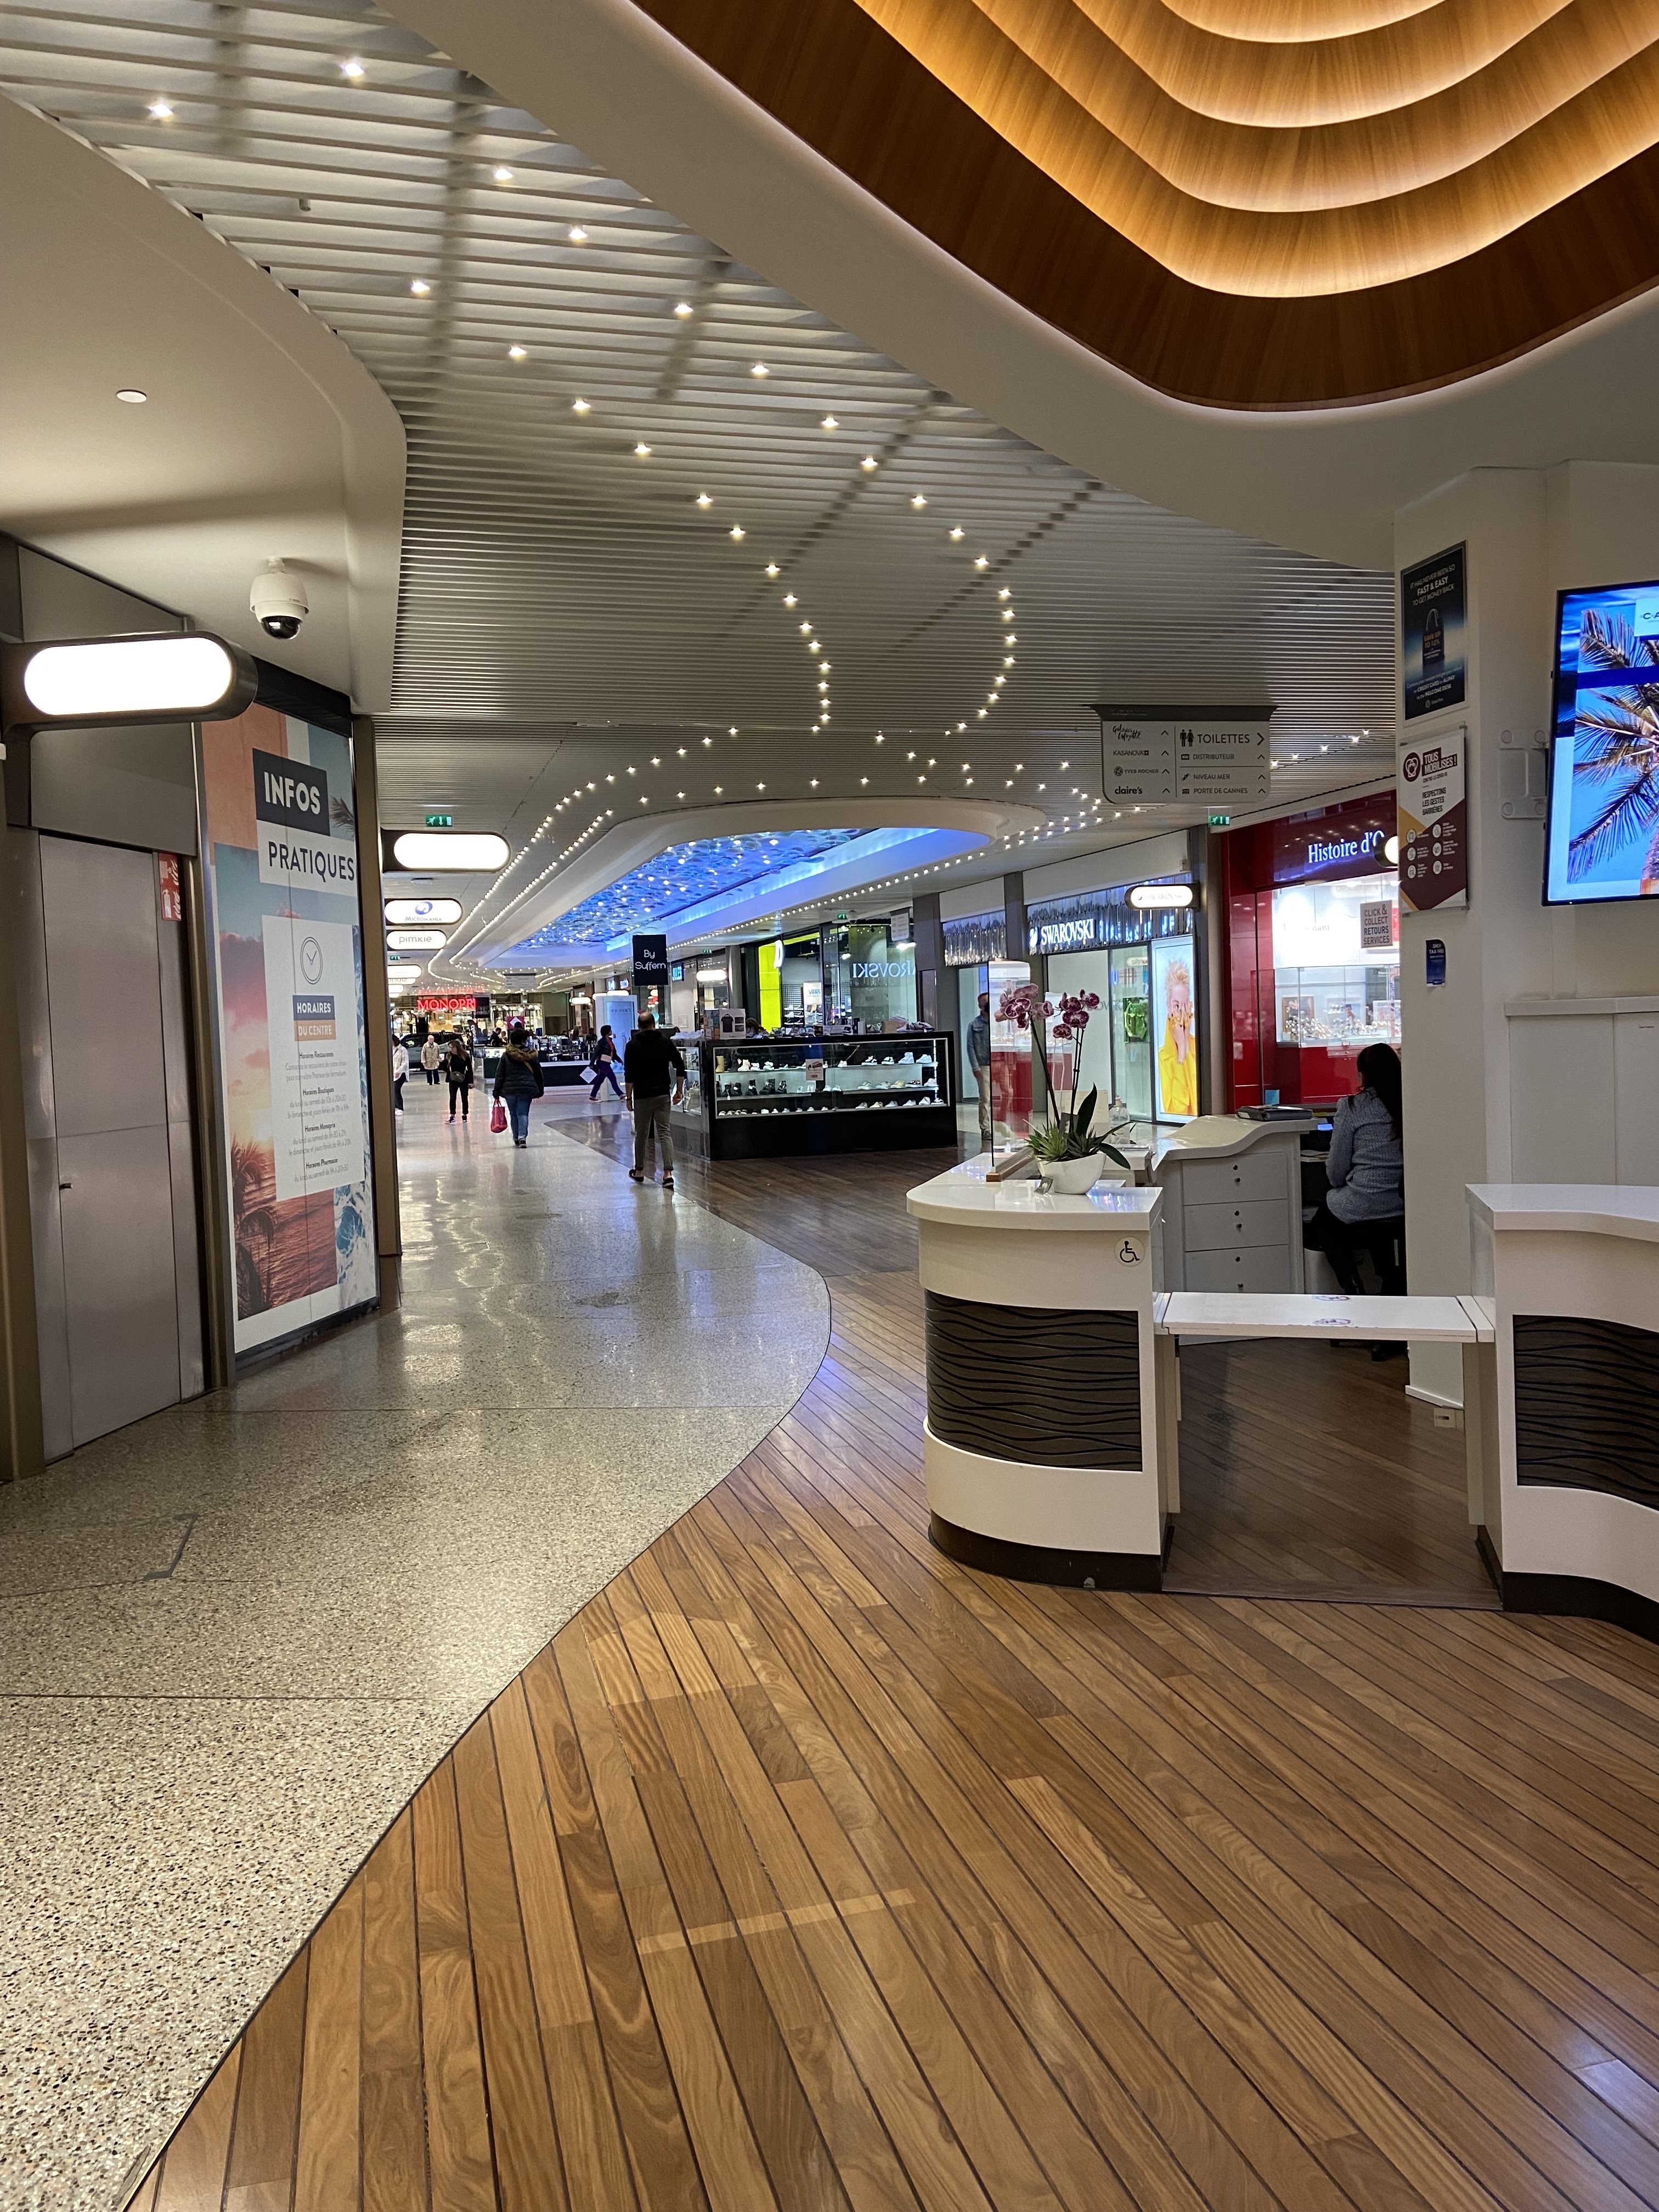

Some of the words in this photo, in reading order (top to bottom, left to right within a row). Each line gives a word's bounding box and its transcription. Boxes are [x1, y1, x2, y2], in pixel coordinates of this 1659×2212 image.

[1417, 584, 1430, 596] FAST
[1435, 575, 1448, 588] EASY
[1198, 733, 1250, 744] TOILETTES
[1424, 752, 1439, 764] TOUS
[264, 771, 320, 815] INFOS
[1114, 786, 1143, 794] claire's
[1422, 787, 1446, 799] RESPECTONS
[1430, 796, 1444, 805] GESTES
[1308, 838, 1358, 864] Histoire
[268, 840, 355, 883] PRATIQUES
[1364, 907, 1381, 917] CLICK
[1381, 904, 1387, 915] &
[1364, 916, 1388, 926] COLLECT
[1042, 918, 1094, 945] SWAROVSKI
[1364, 926, 1389, 935] RETOURS
[399, 936, 432, 944] pimkie
[1363, 935, 1390, 945] SERVICES
[644, 950, 655, 959] By
[297, 1002, 331, 1014] HORAIRES
[417, 998, 476, 1011] MONOPRI
[298, 1025, 308, 1036] DU
[309, 1024, 332, 1036] CENTRE
[306, 1161, 320, 1169] Horaires
